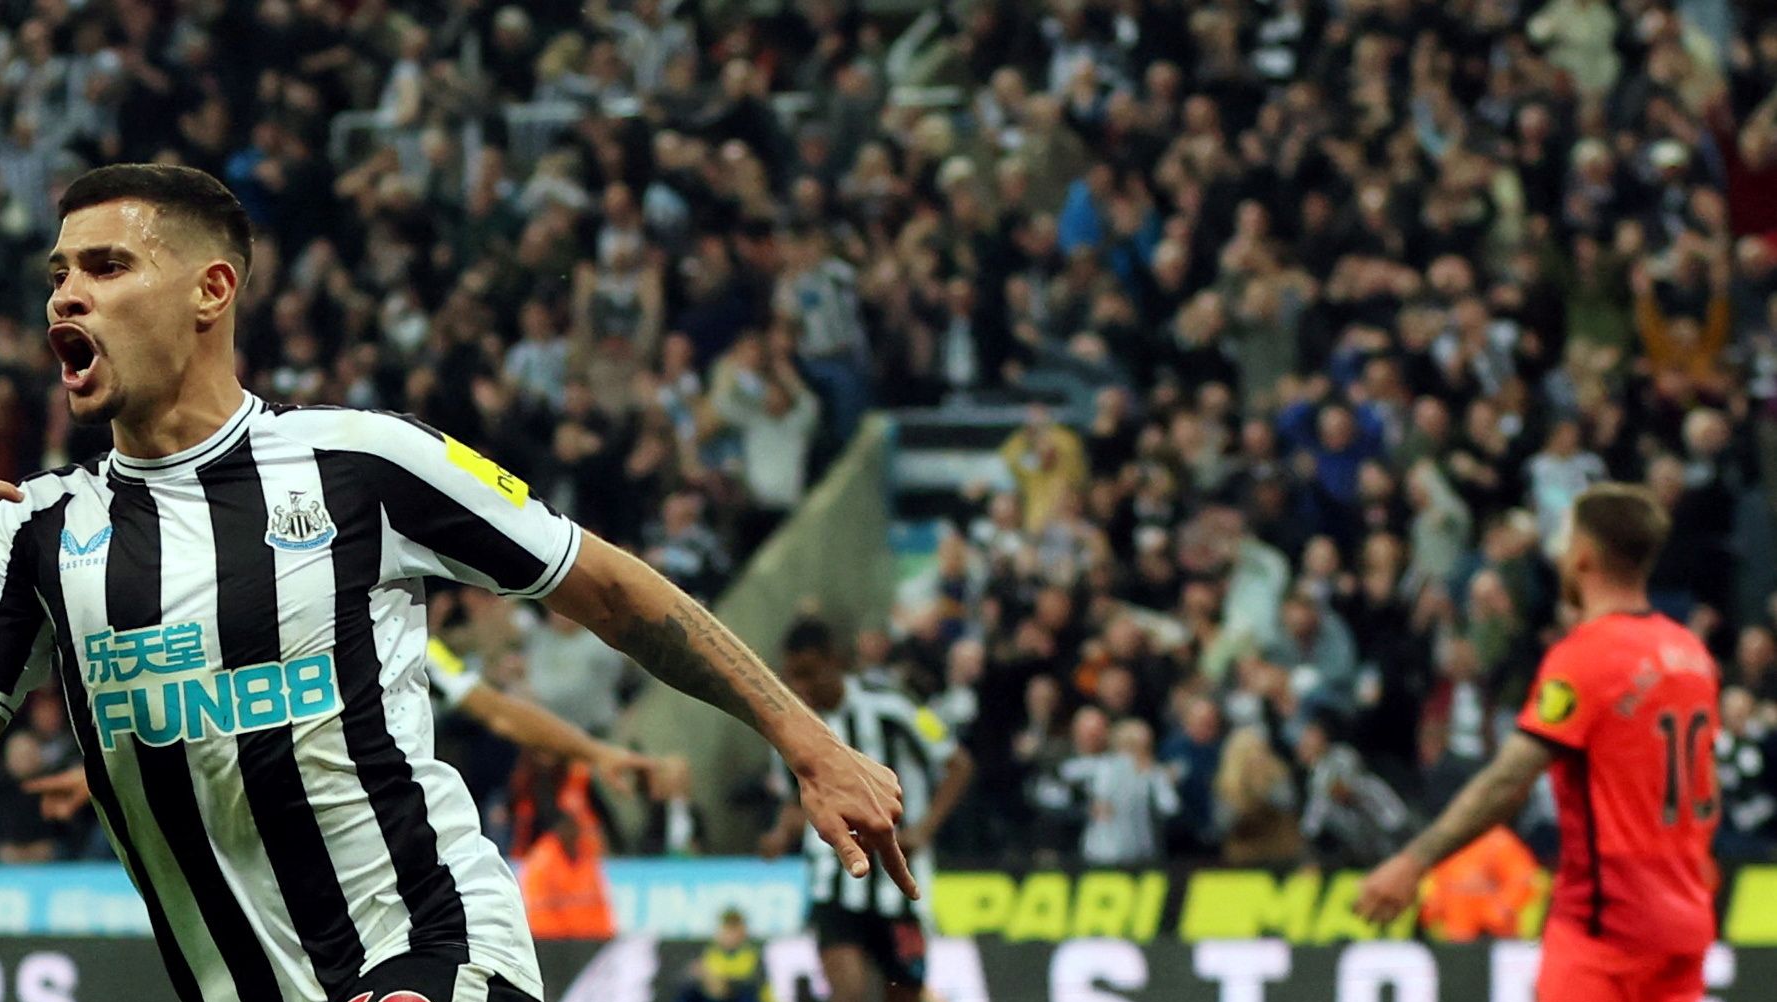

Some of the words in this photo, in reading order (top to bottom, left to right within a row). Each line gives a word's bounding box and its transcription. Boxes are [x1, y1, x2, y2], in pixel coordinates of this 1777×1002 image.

[84, 621, 206, 683] 乐天堂
[93, 654, 336, 749] FUN88
[934, 872, 1168, 944] PARI
